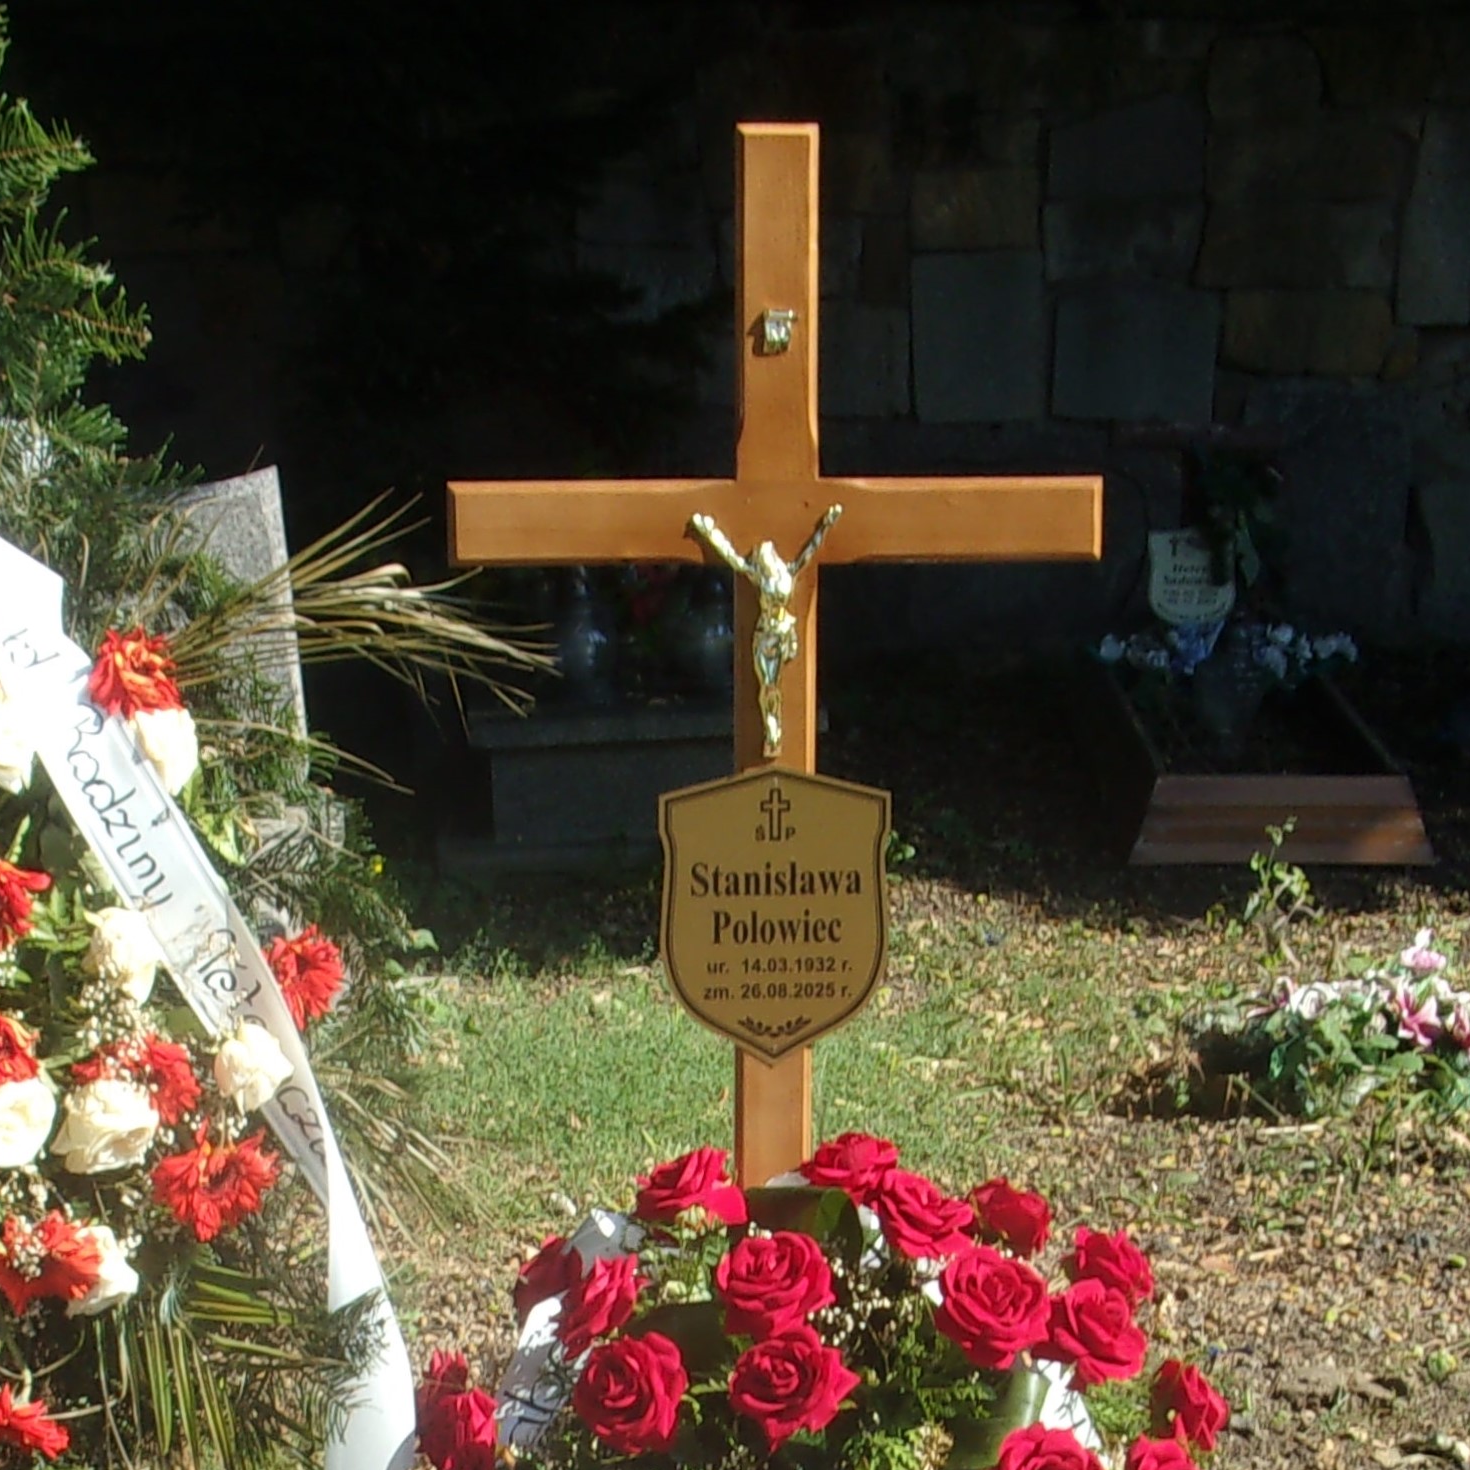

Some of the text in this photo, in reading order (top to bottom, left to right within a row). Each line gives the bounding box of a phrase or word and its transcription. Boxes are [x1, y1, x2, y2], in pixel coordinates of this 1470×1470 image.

[690, 861, 862, 897] Stanisława
[712, 908, 843, 945] Polowiec
[706, 956, 853, 975] ur. 14.03.1932 r.
[740, 981, 836, 1000] 26.08.2025
[840, 984, 852, 999] r.
